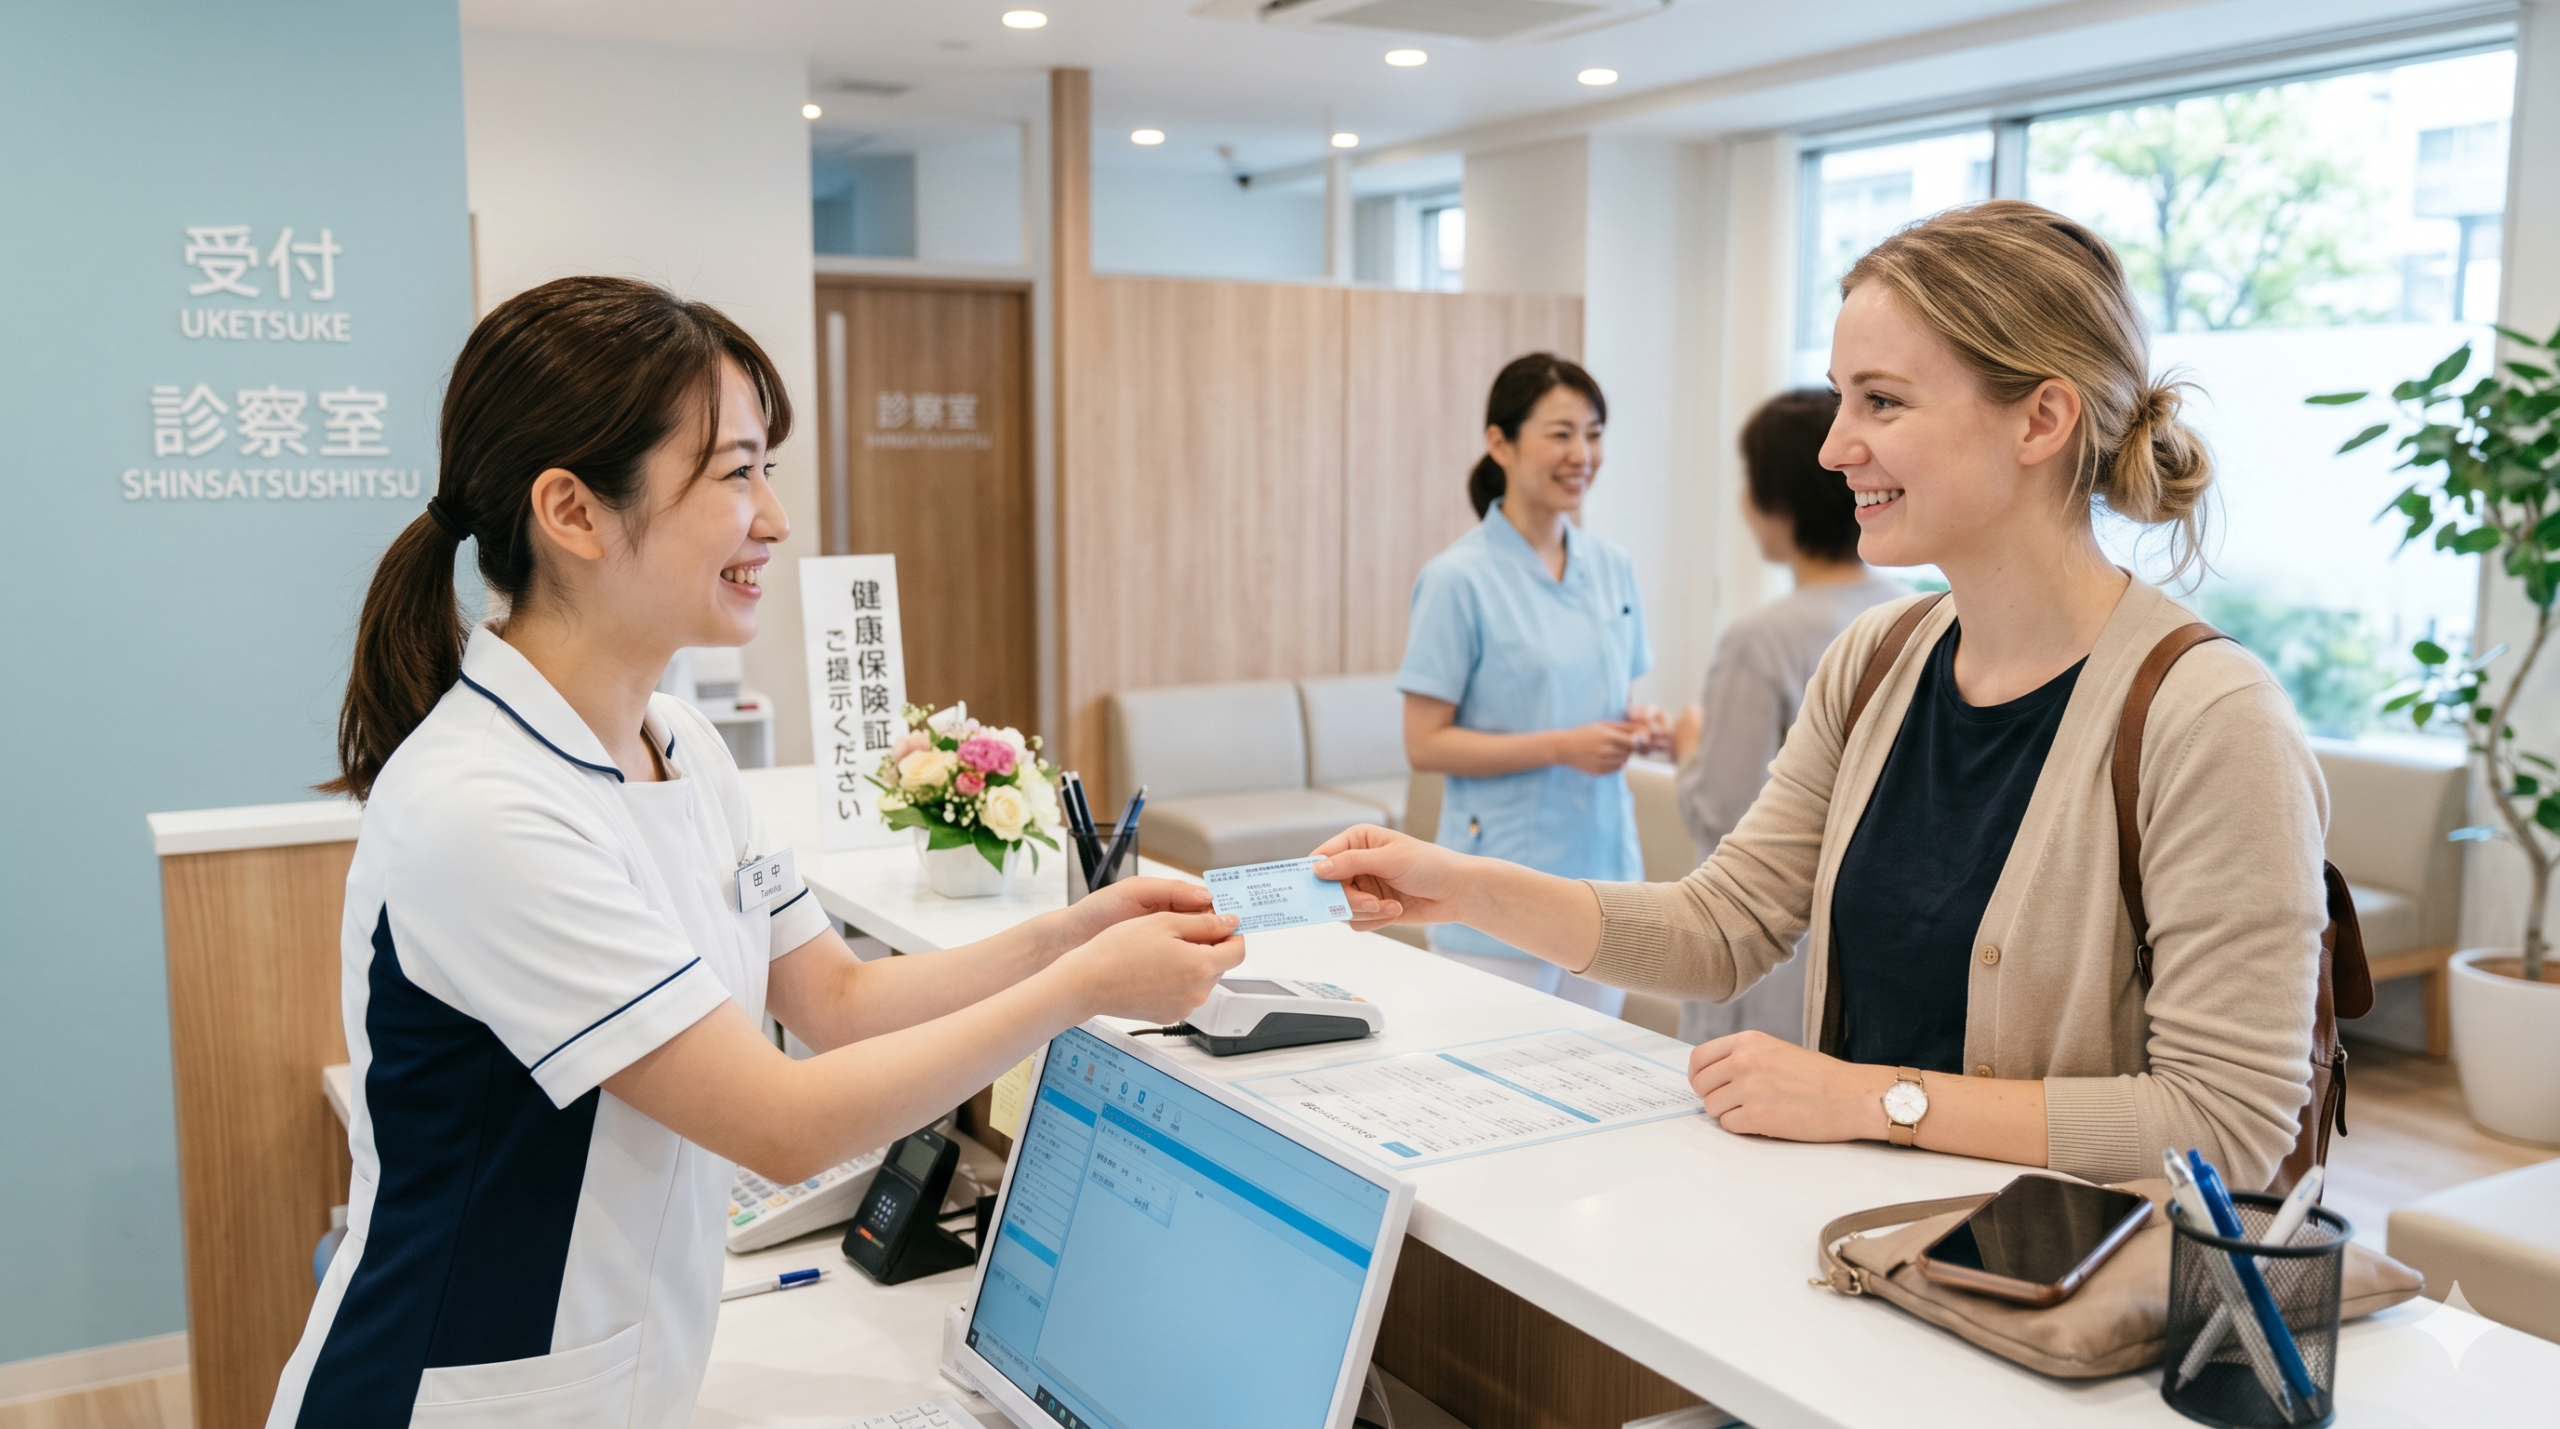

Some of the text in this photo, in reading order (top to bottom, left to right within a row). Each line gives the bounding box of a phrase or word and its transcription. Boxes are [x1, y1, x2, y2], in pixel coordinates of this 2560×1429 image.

[184, 224, 343, 300] 受付
[180, 308, 351, 342] UKETSUKE
[150, 384, 391, 457] 診察室
[122, 468, 421, 500] SHINSATSUSHITSU
[851, 579, 893, 751] 健康保険証
[826, 629, 861, 820] ご提示ください
